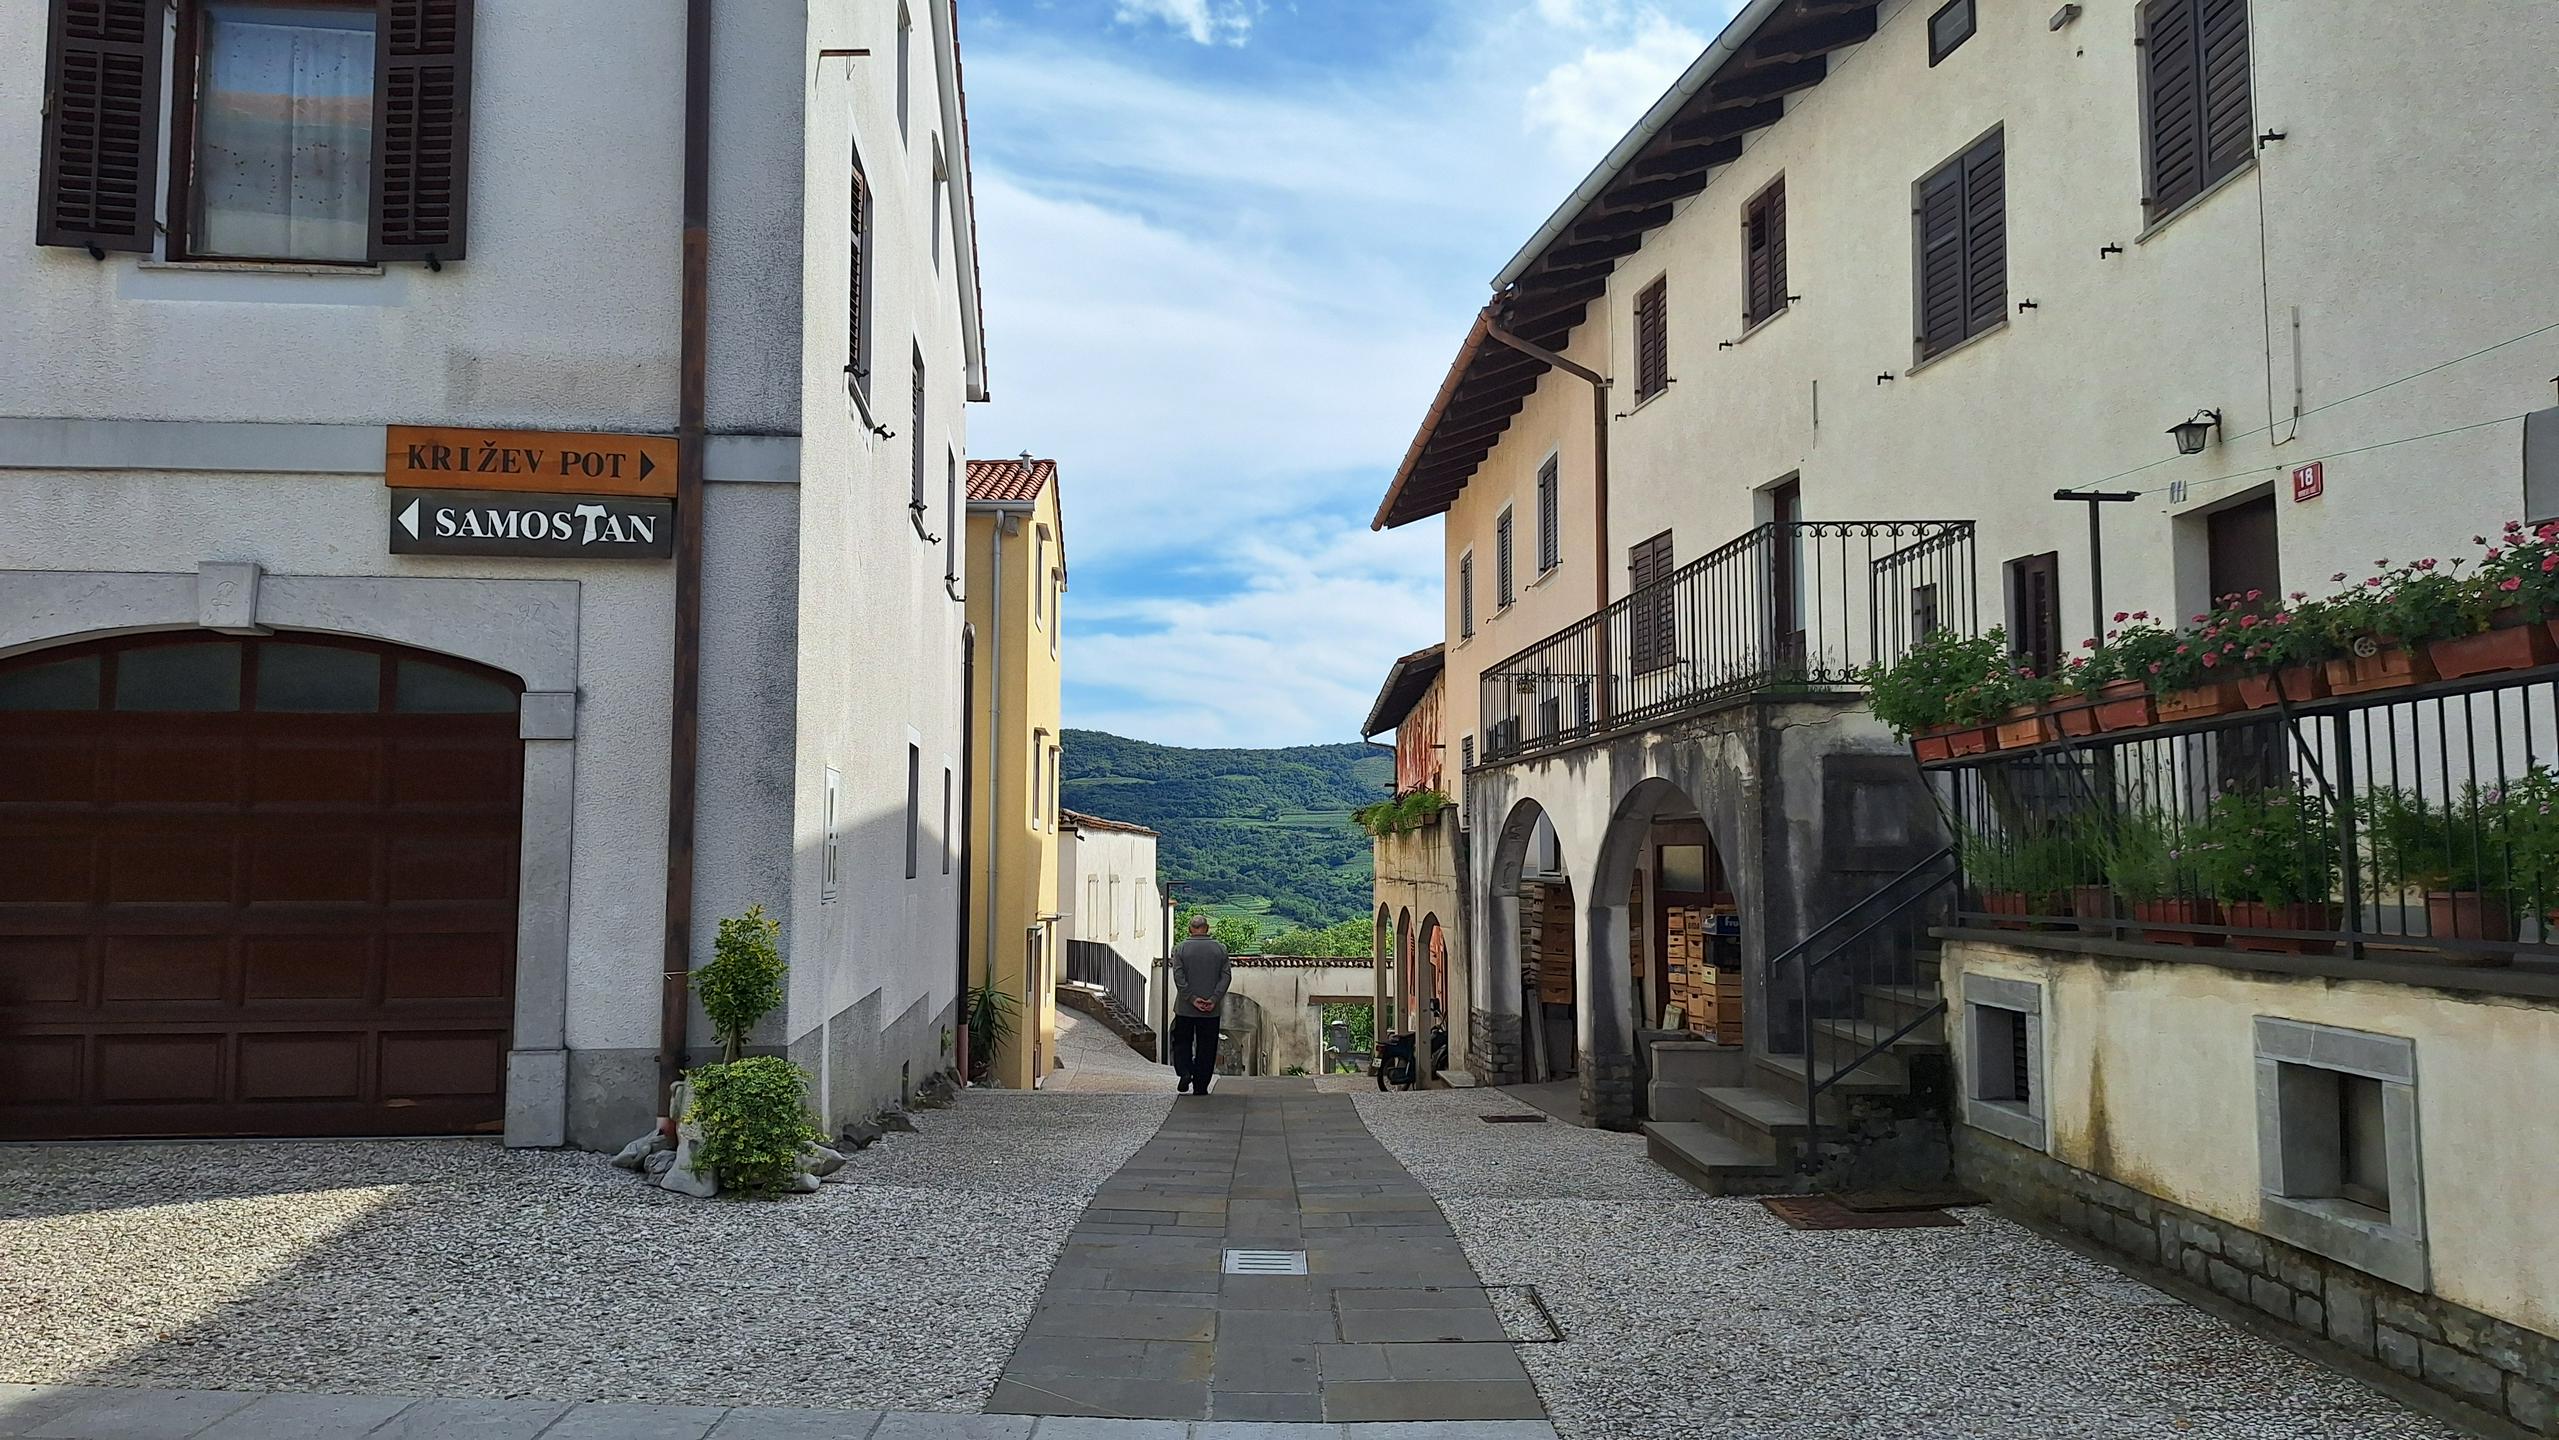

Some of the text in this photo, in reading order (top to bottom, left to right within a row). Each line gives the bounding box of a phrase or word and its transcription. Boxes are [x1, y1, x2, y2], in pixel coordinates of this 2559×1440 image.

[407, 440, 626, 478] KRIŽEV POT
[2299, 467, 2313, 488] 18
[435, 504, 657, 546] SAMOSTAN
